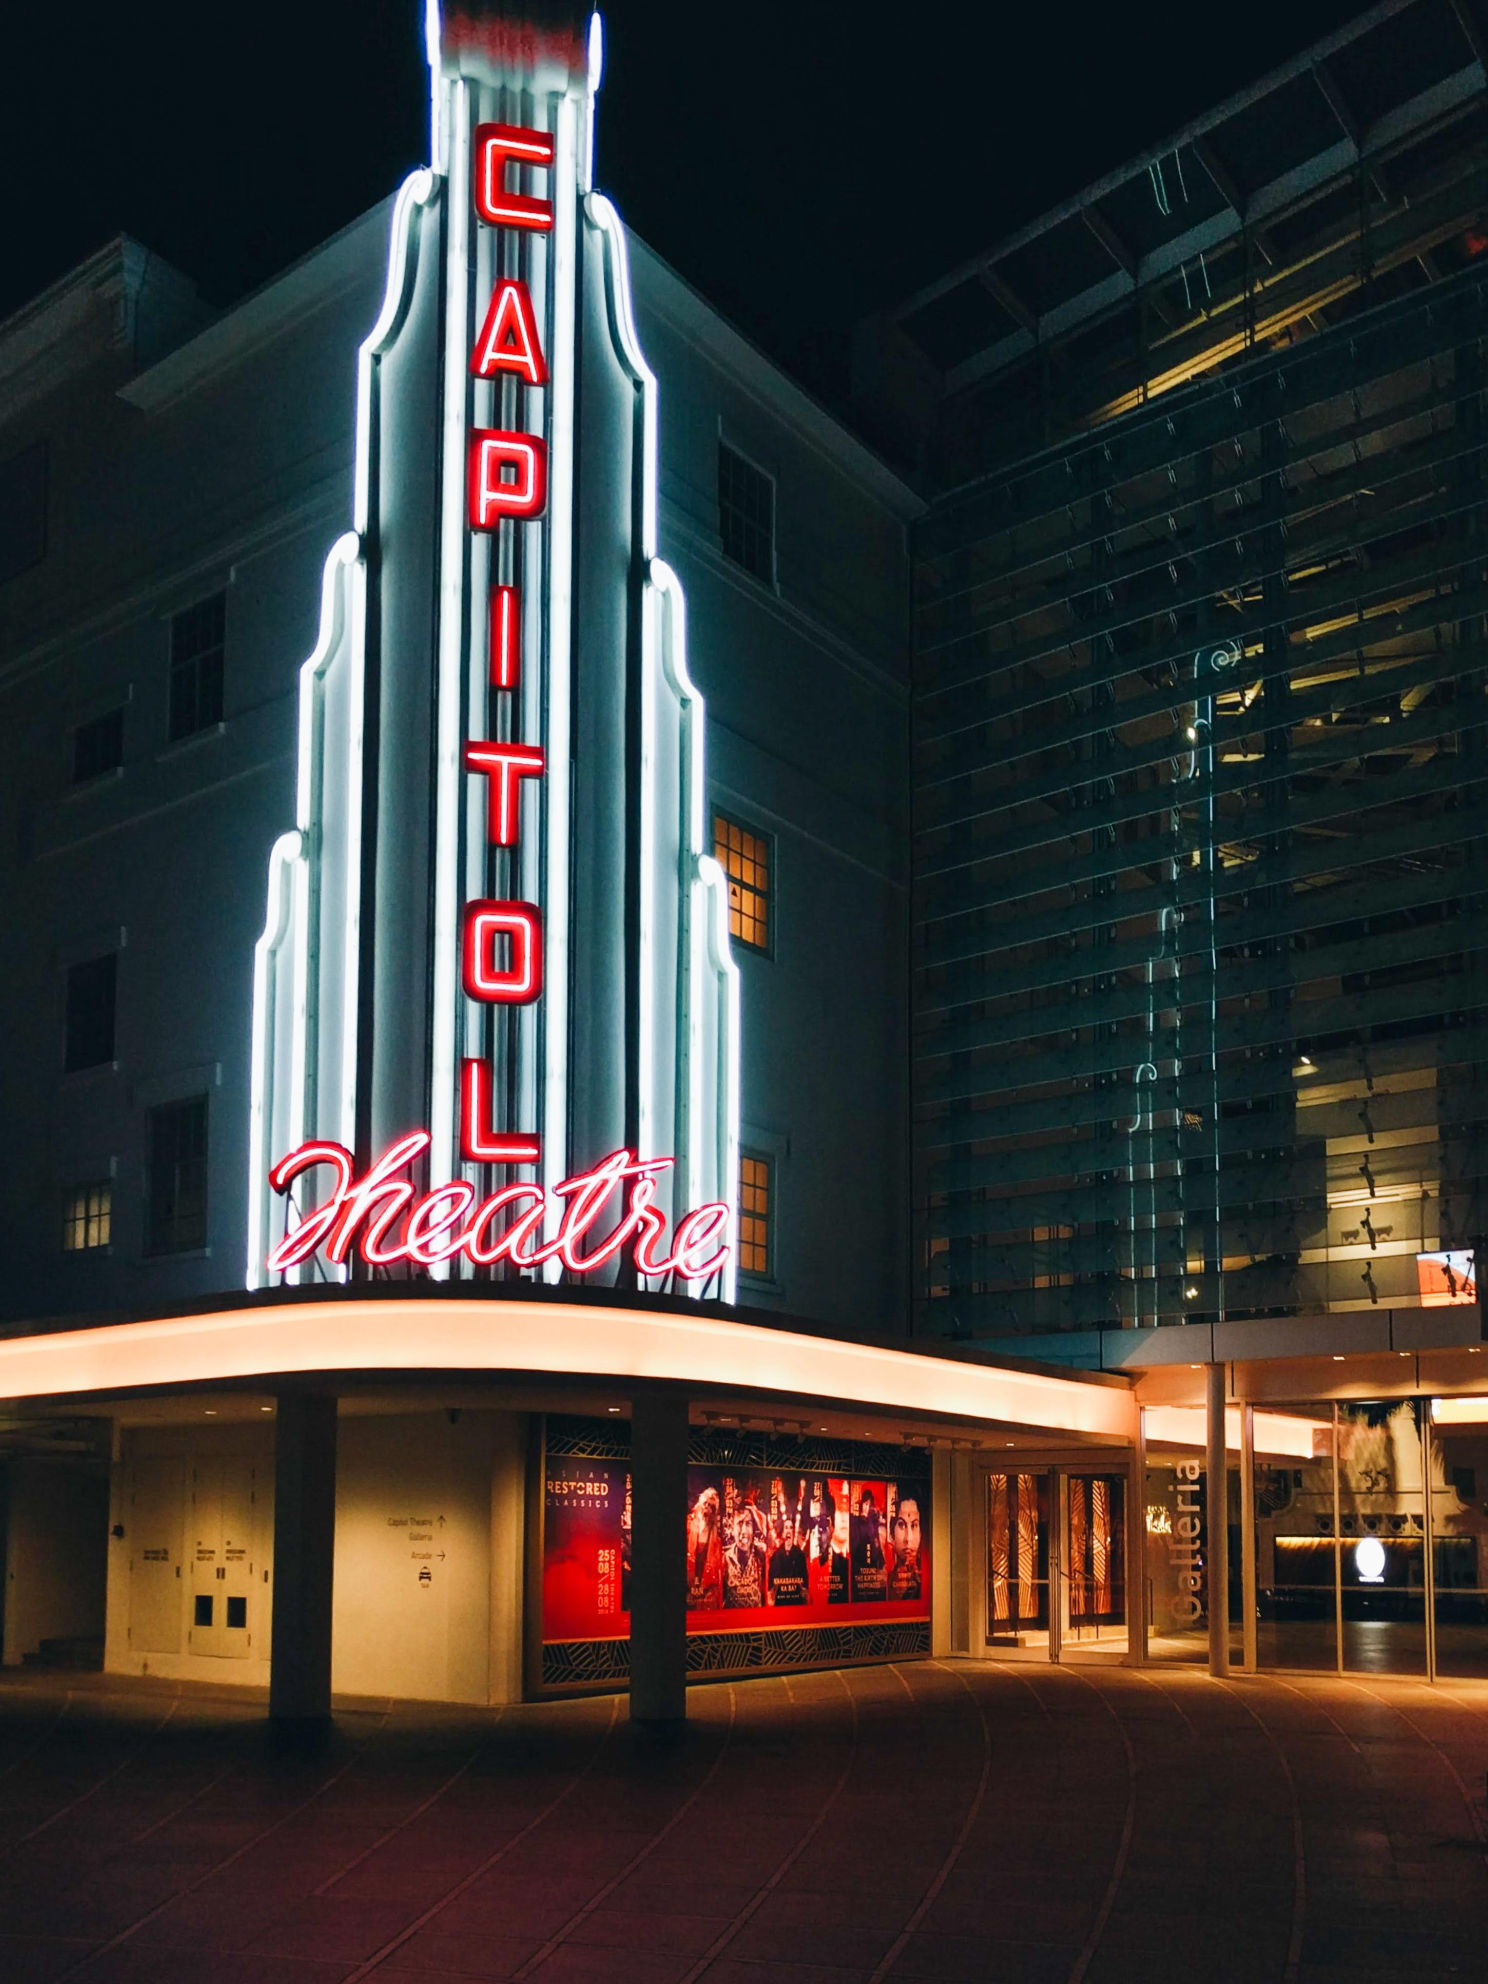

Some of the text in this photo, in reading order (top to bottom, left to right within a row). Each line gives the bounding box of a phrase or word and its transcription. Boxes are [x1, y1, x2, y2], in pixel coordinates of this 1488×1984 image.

[460, 122, 555, 1164] CAPITOL
[268, 1129, 734, 1279] Theatre
[547, 1481, 609, 1496] RESTORED
[546, 1499, 609, 1508] CLASSICS
[1168, 1459, 1202, 1621] Galleria
[598, 1549, 610, 1561] 25
[598, 1562, 610, 1574] 08
[598, 1584, 610, 1595] 28
